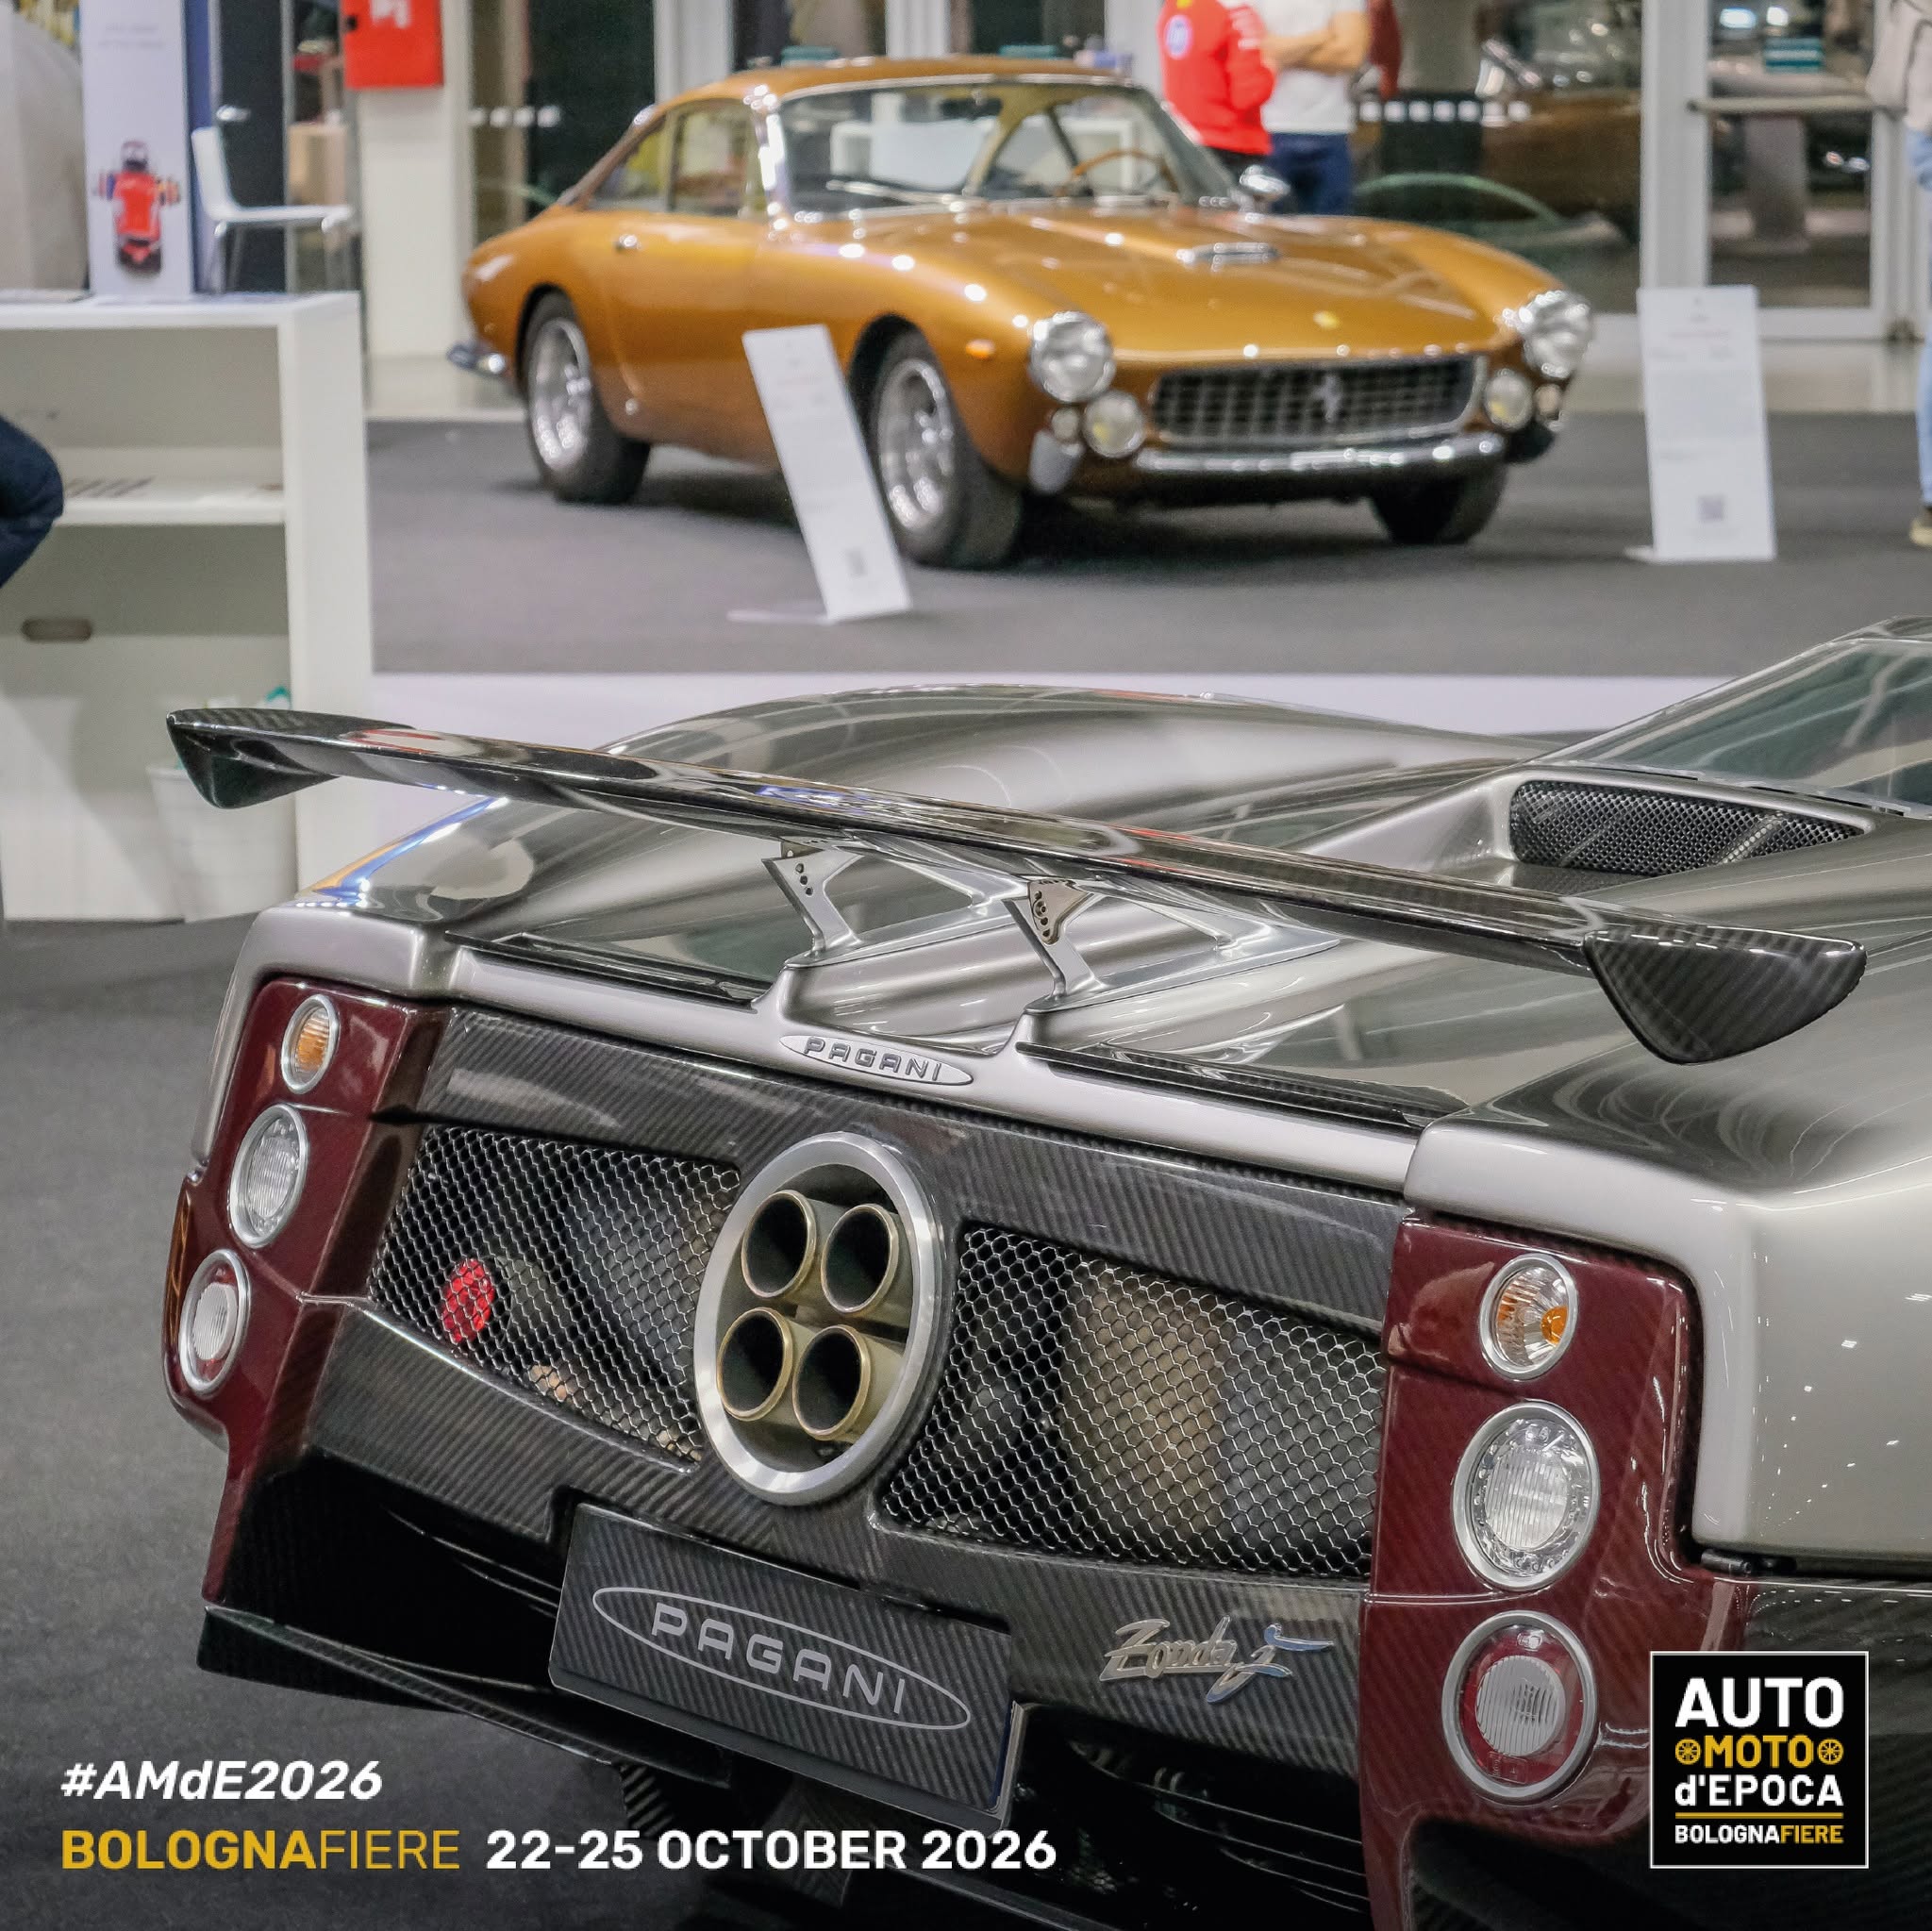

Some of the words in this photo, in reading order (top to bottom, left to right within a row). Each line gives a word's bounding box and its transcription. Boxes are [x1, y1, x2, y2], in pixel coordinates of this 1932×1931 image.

[804, 1037, 941, 1081] PAGANI
[651, 1602, 906, 1714] PAGANI
[1100, 1615, 1238, 1681] Zonda
